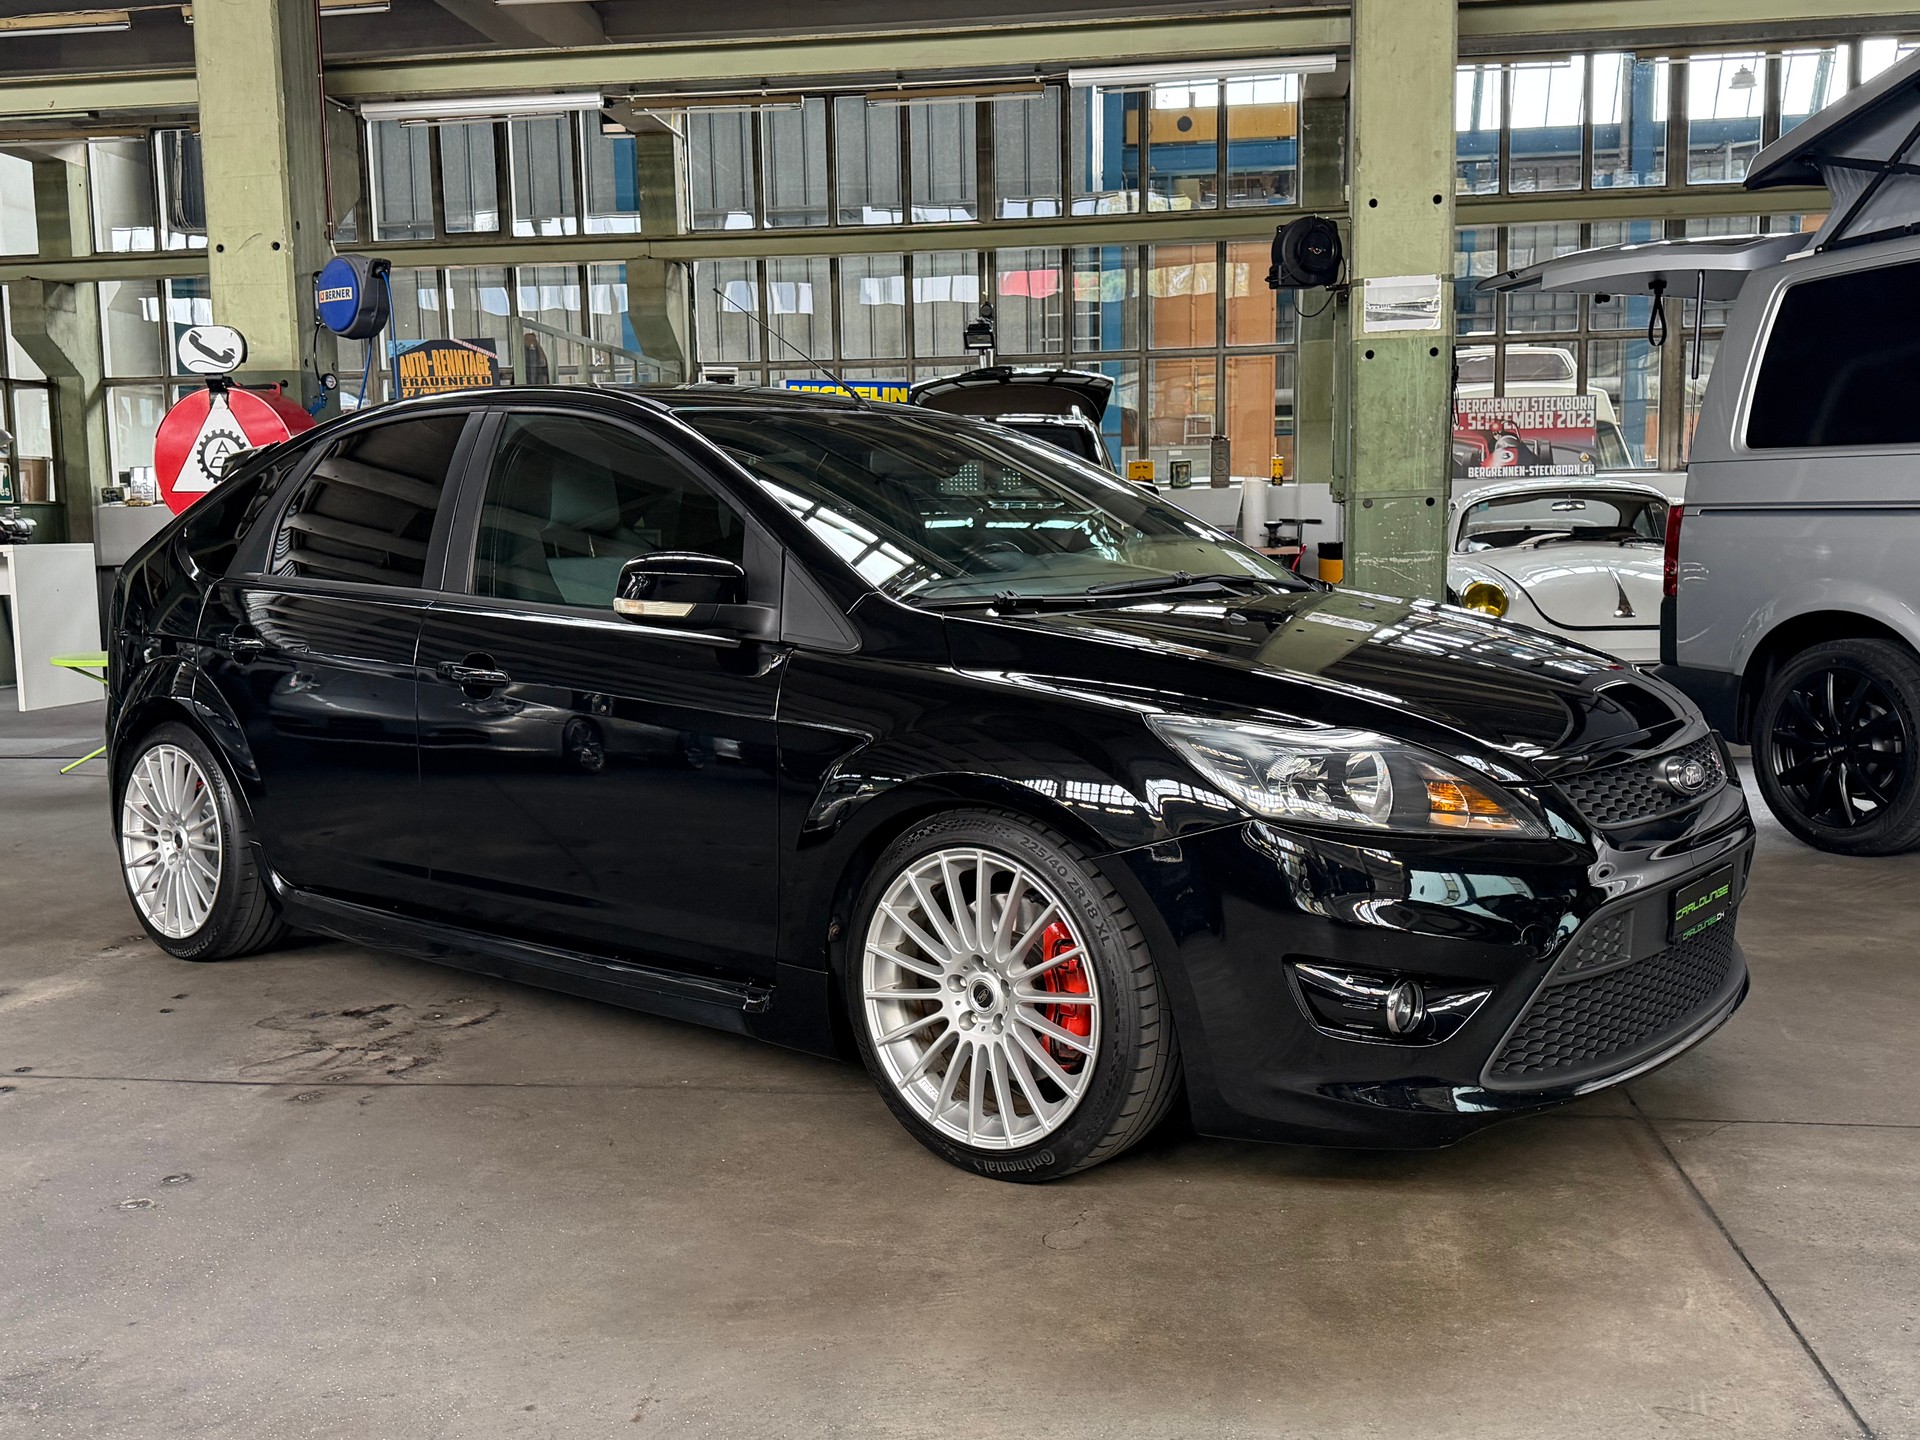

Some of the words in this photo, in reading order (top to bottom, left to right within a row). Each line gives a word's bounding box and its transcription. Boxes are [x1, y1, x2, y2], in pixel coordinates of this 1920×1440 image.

[325, 288, 351, 300] BERNER
[400, 349, 491, 377] AUTO-RENNTAGE
[402, 376, 492, 387] FRAUENFELD
[1458, 398, 1528, 413] BERGRENNEN
[1531, 396, 1595, 411] STECKBORN
[1557, 410, 1595, 428] 2023
[1468, 464, 1595, 478] BERGRENNEN-STECKBORN.CH
[1020, 837, 1068, 877] 225/40
[1067, 878, 1085, 900] ZR
[1083, 900, 1098, 920] 18
[1095, 922, 1111, 947] XL
[1676, 883, 1730, 920] CARLOUNGE
[984, 1148, 1056, 1174] Continental
